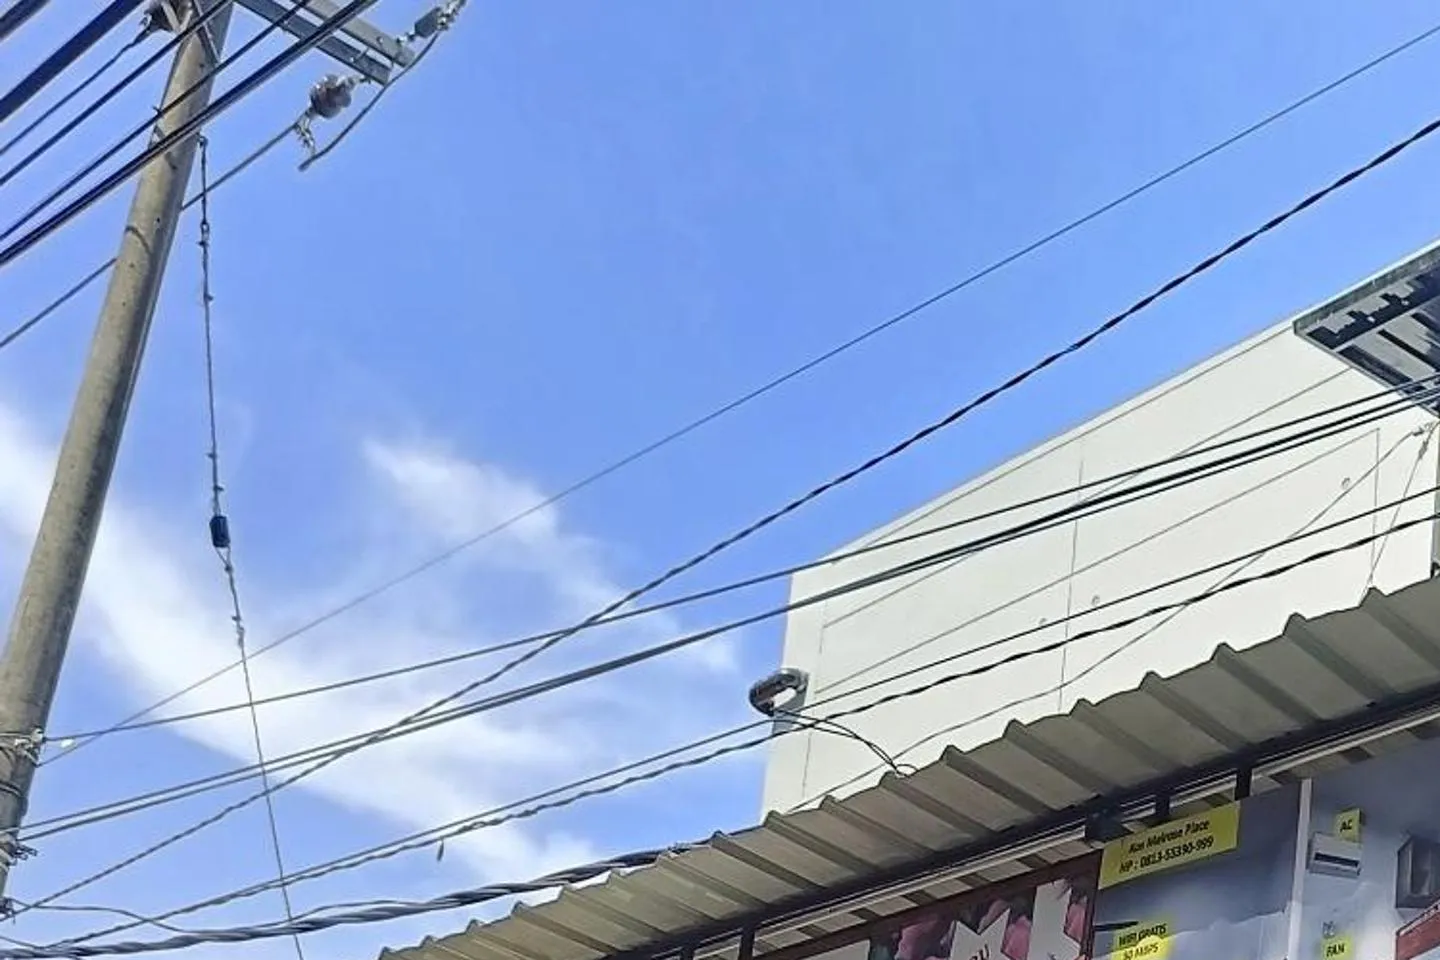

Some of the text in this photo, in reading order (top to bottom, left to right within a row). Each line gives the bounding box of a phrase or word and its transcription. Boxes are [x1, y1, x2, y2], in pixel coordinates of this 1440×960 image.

[1340, 819, 1353, 832] AC
[1138, 923, 1167, 941] GRATIS
[1326, 943, 1345, 958] FAN
